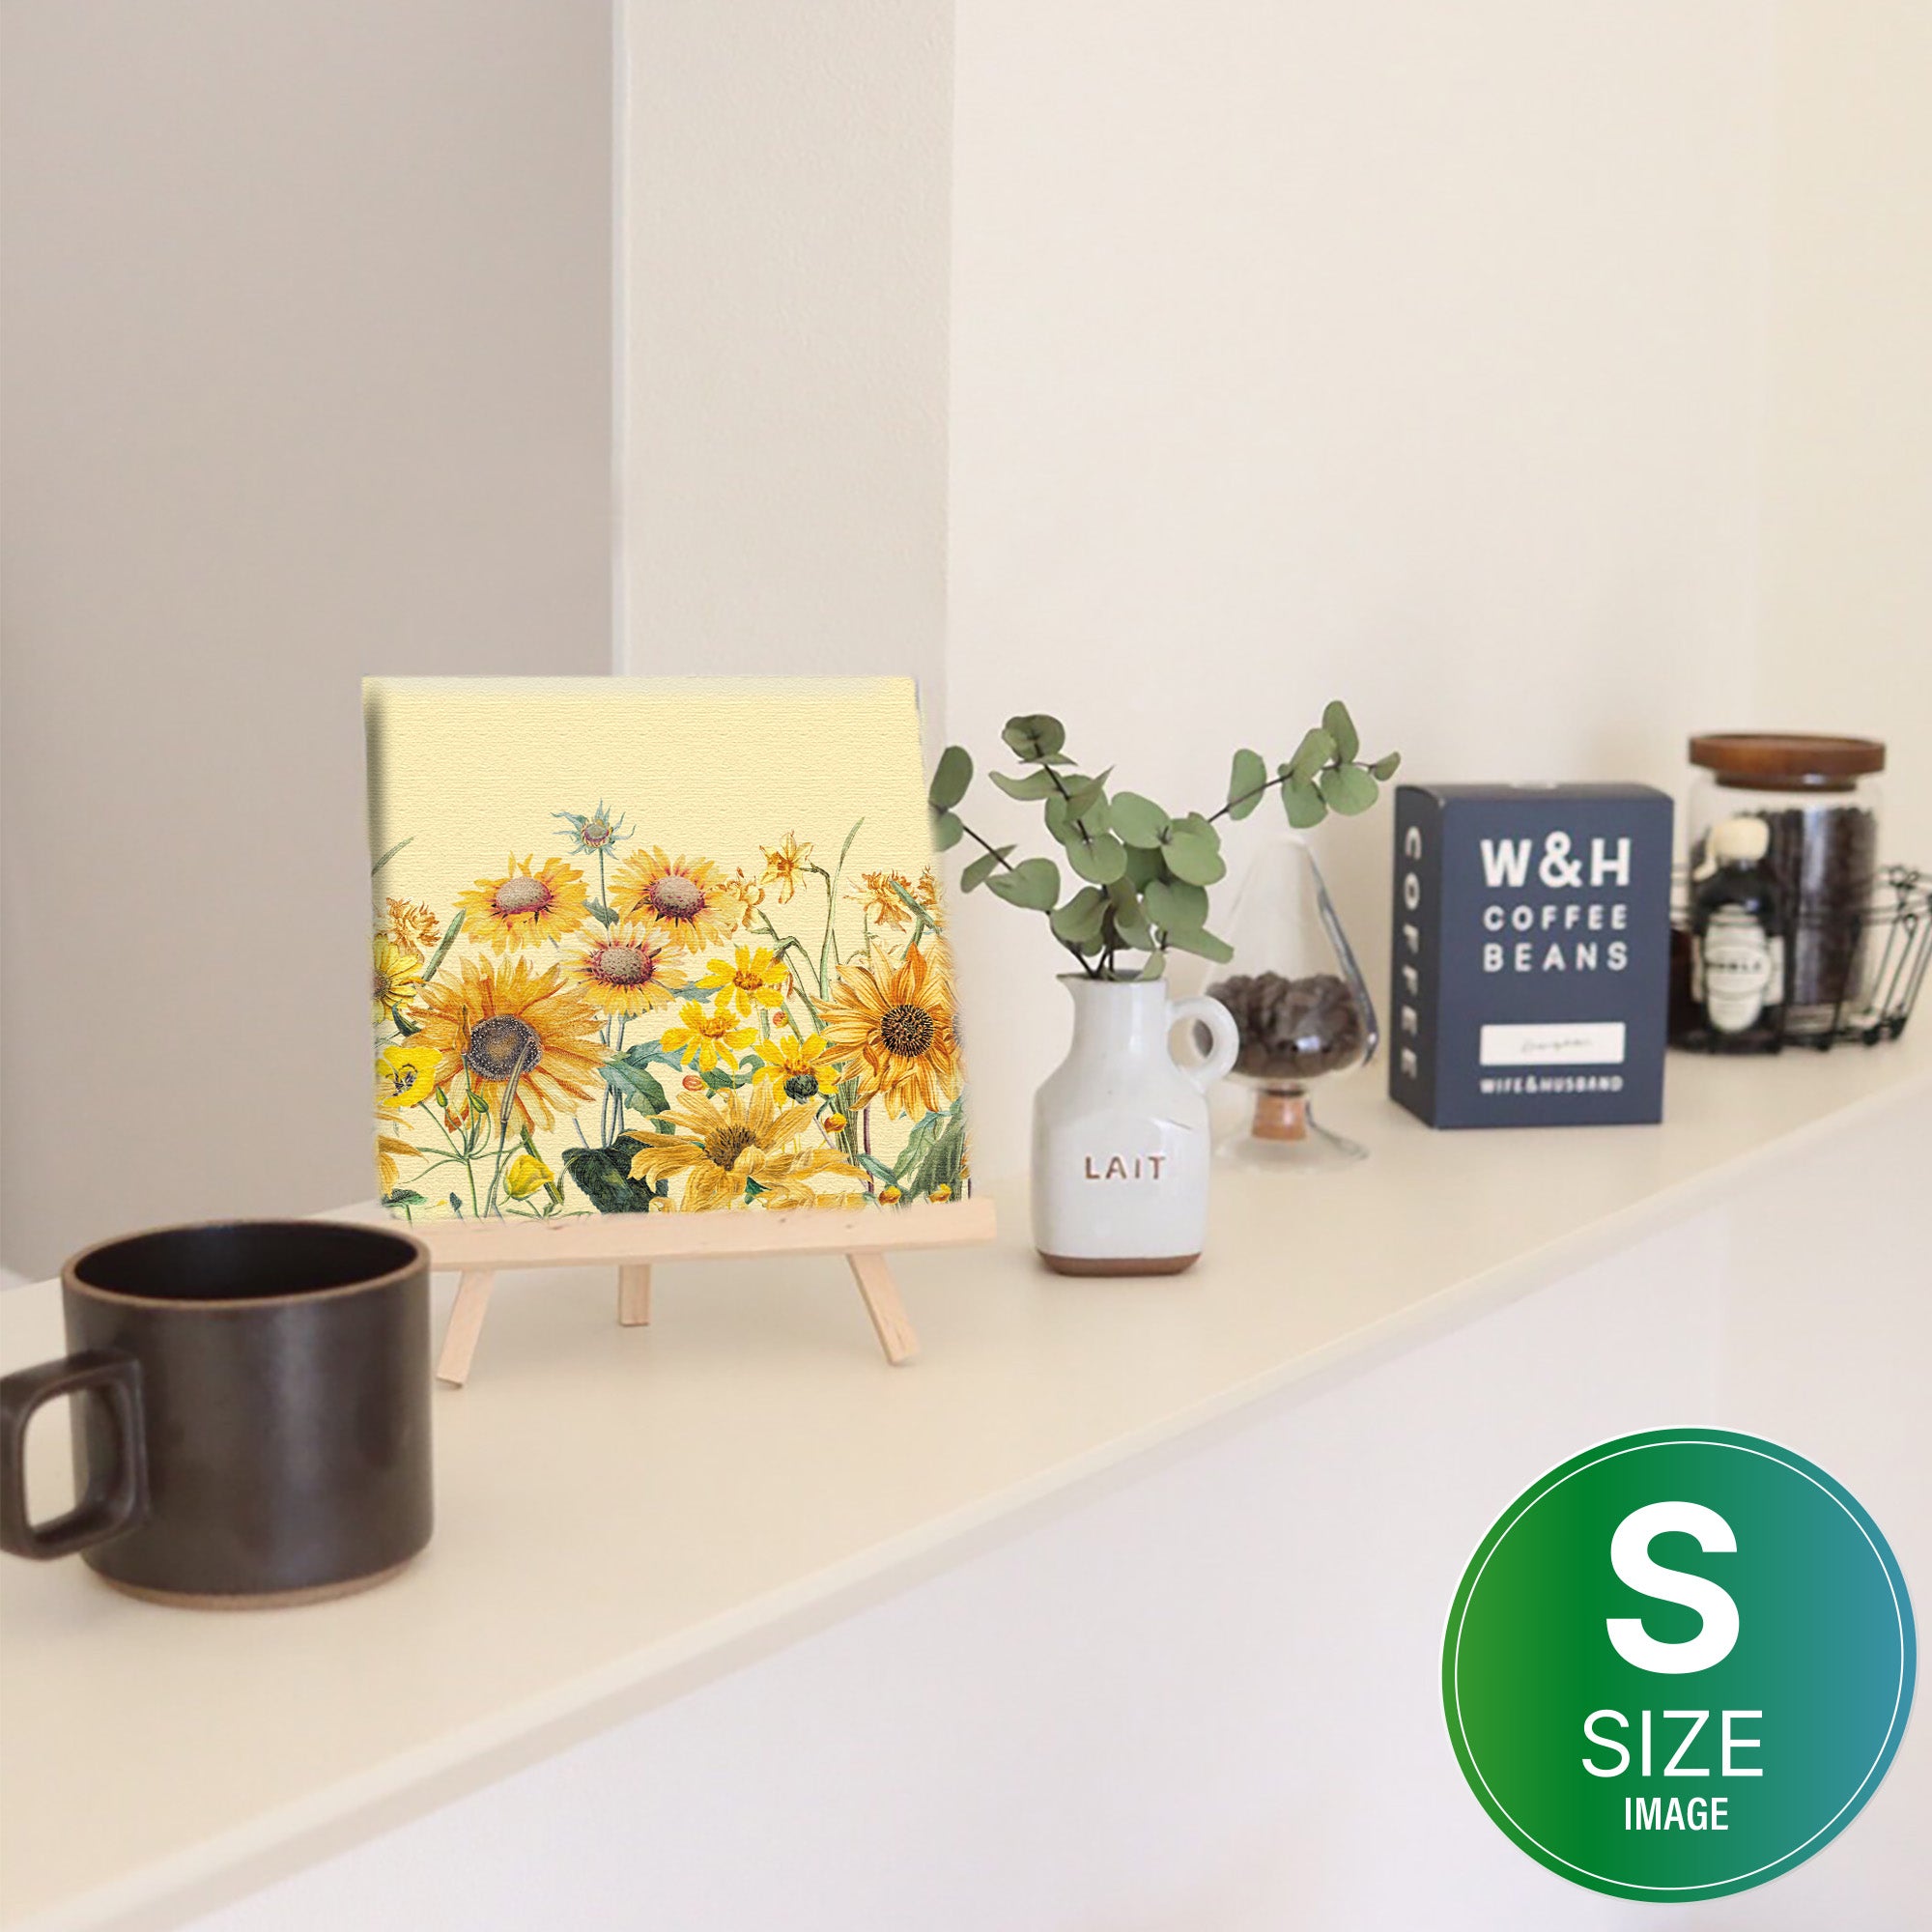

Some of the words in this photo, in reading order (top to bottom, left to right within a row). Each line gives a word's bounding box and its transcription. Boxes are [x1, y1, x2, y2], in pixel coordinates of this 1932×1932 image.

[1480, 831, 1631, 888] W&H
[1483, 904, 1627, 930] COFFEE
[1483, 942, 1629, 972] BEANS
[1085, 1155, 1165, 1180] LAIT
